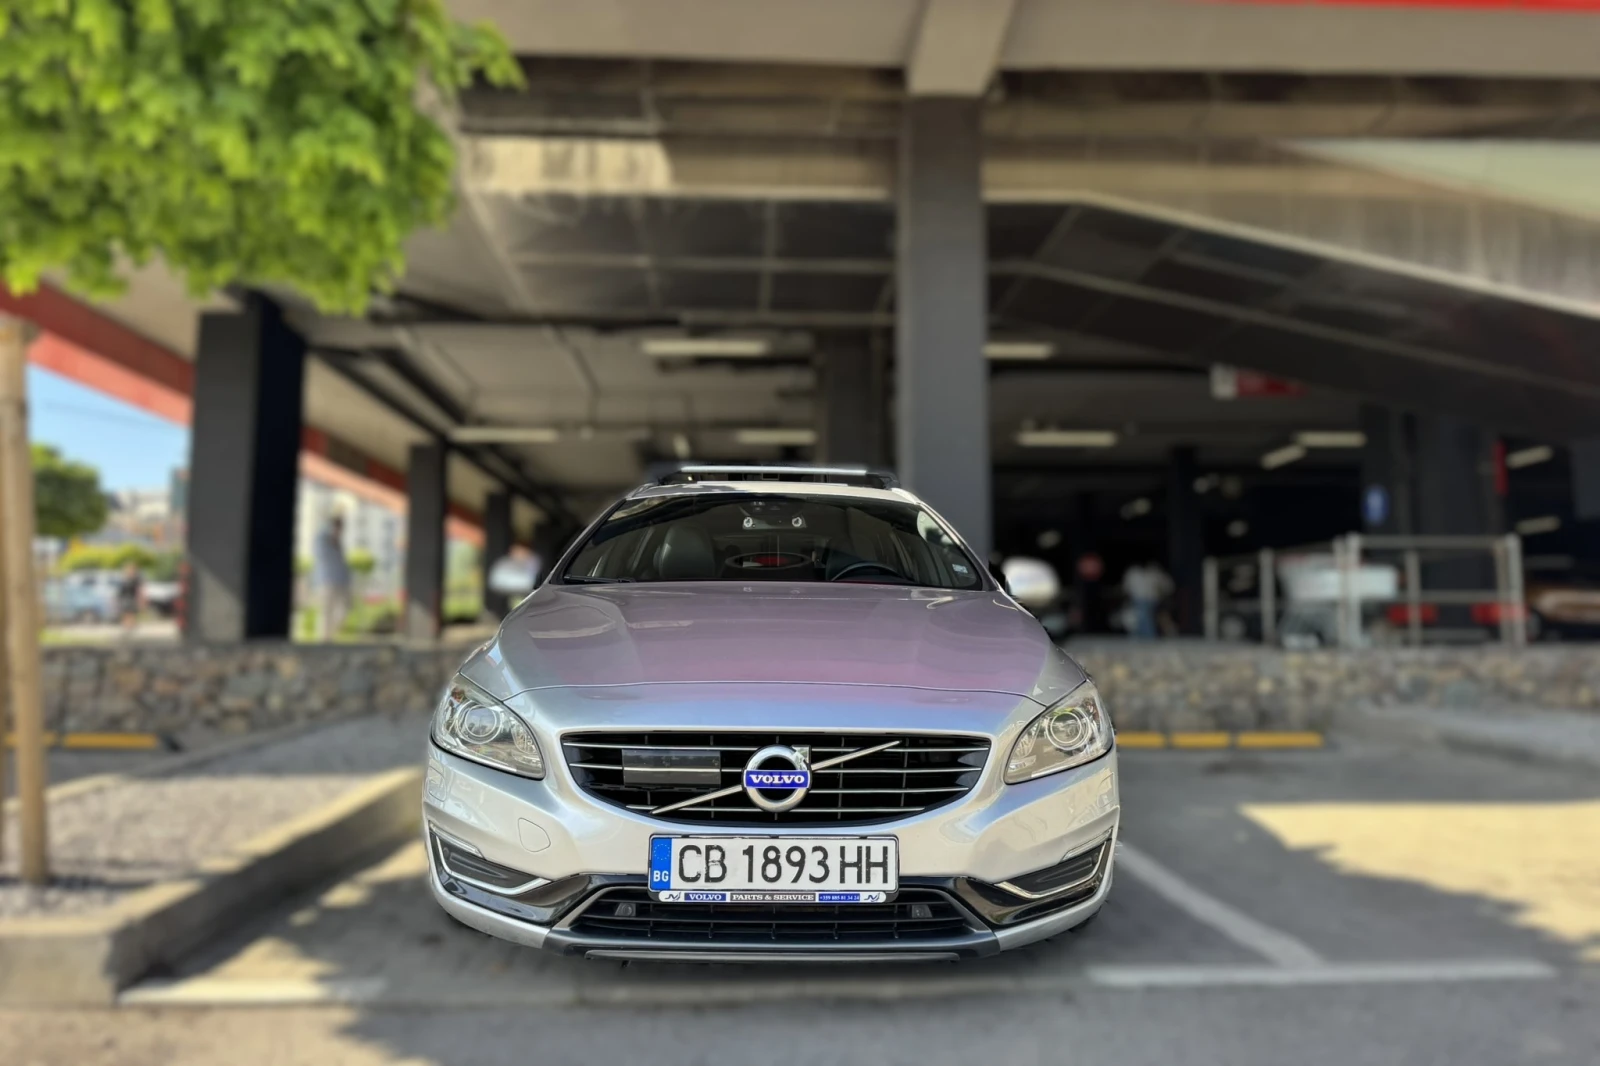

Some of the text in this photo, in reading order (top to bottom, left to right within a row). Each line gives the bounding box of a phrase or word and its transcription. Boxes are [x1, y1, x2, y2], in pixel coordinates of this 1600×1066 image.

[749, 774, 805, 784] VOLVO
[678, 844, 888, 884] CB 1893 HH
[653, 870, 669, 882] BG
[689, 893, 722, 901] VOLVO
